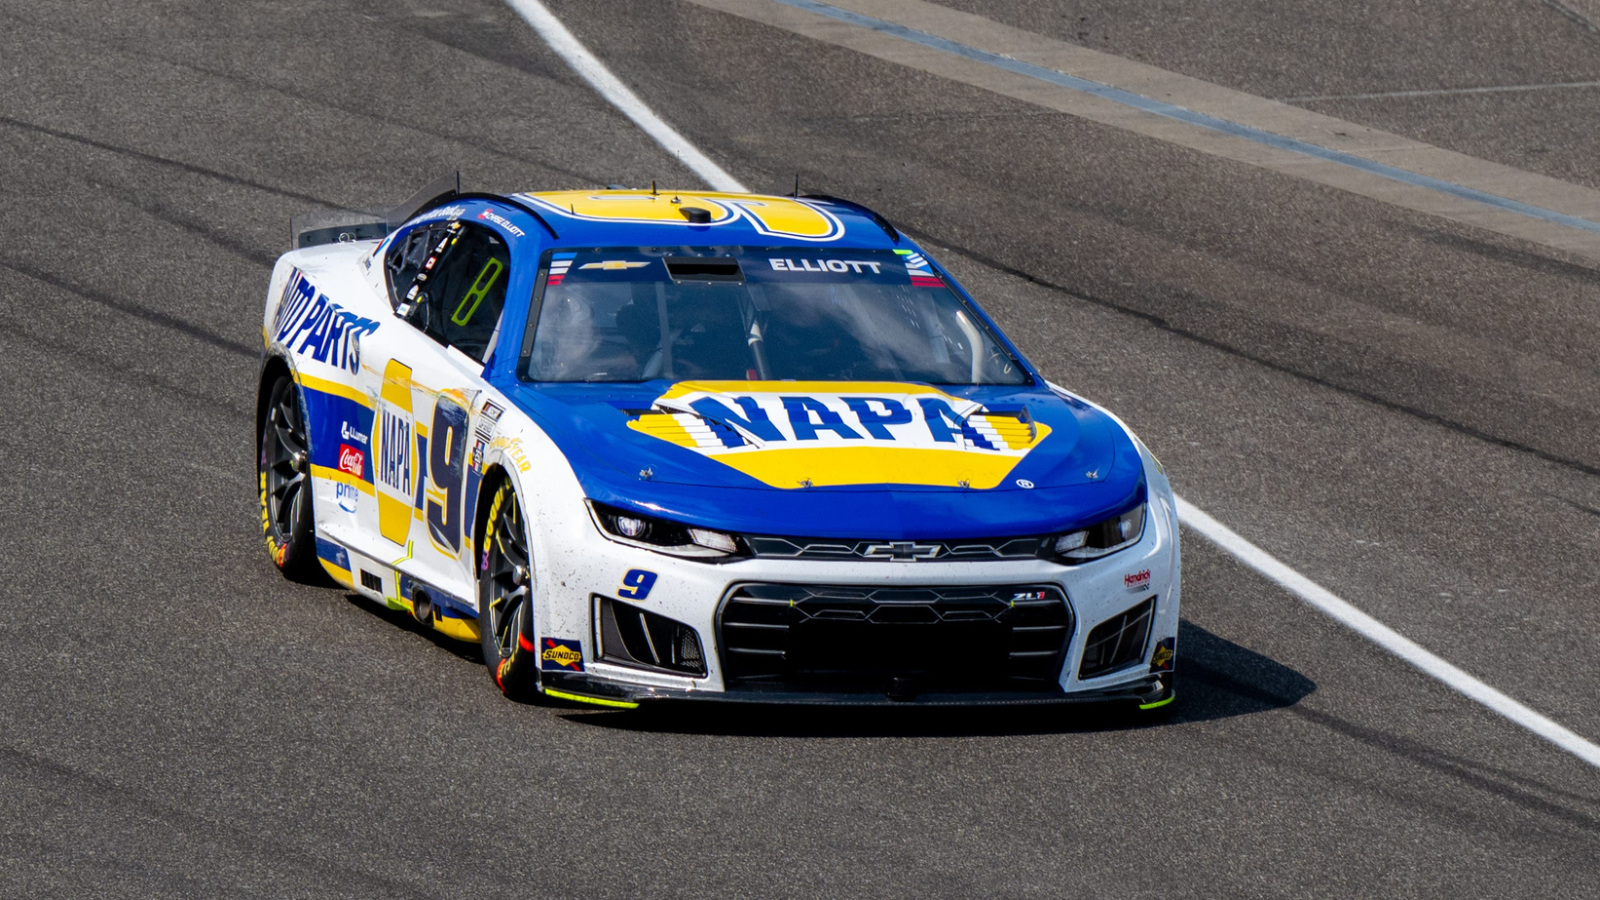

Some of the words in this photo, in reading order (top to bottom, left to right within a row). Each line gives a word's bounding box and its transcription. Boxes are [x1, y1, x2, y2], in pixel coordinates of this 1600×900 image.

[768, 258, 881, 274] ELLIOTT
[286, 293, 381, 376] PARTS
[690, 396, 1002, 450] NAPA
[381, 408, 411, 496] NAPA
[424, 393, 470, 561] 9
[616, 567, 659, 601] 9
[1124, 568, 1151, 588] Hendrick
[1012, 591, 1046, 601] ZL1
[543, 650, 580, 661] SUNOCO
